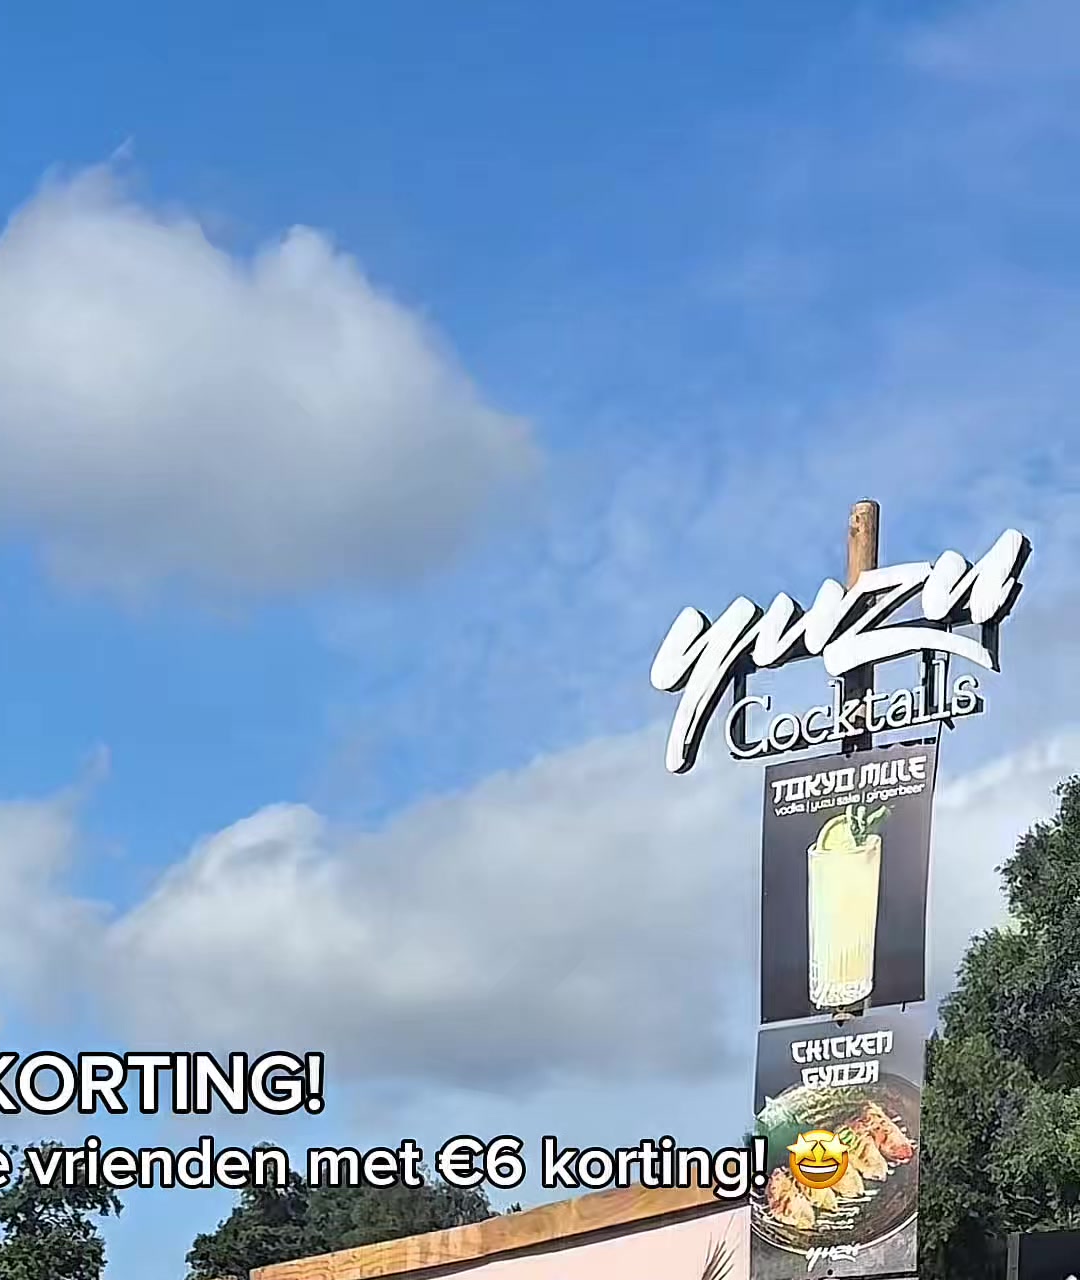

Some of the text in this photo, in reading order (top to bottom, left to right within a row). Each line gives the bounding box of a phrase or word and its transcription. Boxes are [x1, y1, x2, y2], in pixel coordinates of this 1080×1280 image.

[724, 660, 980, 758] Cocktails
[771, 756, 926, 803] TOKYO MULE
[775, 802, 804, 816] vodka
[791, 1030, 893, 1063] CHICKEN
[801, 1060, 880, 1088] GYOZA
